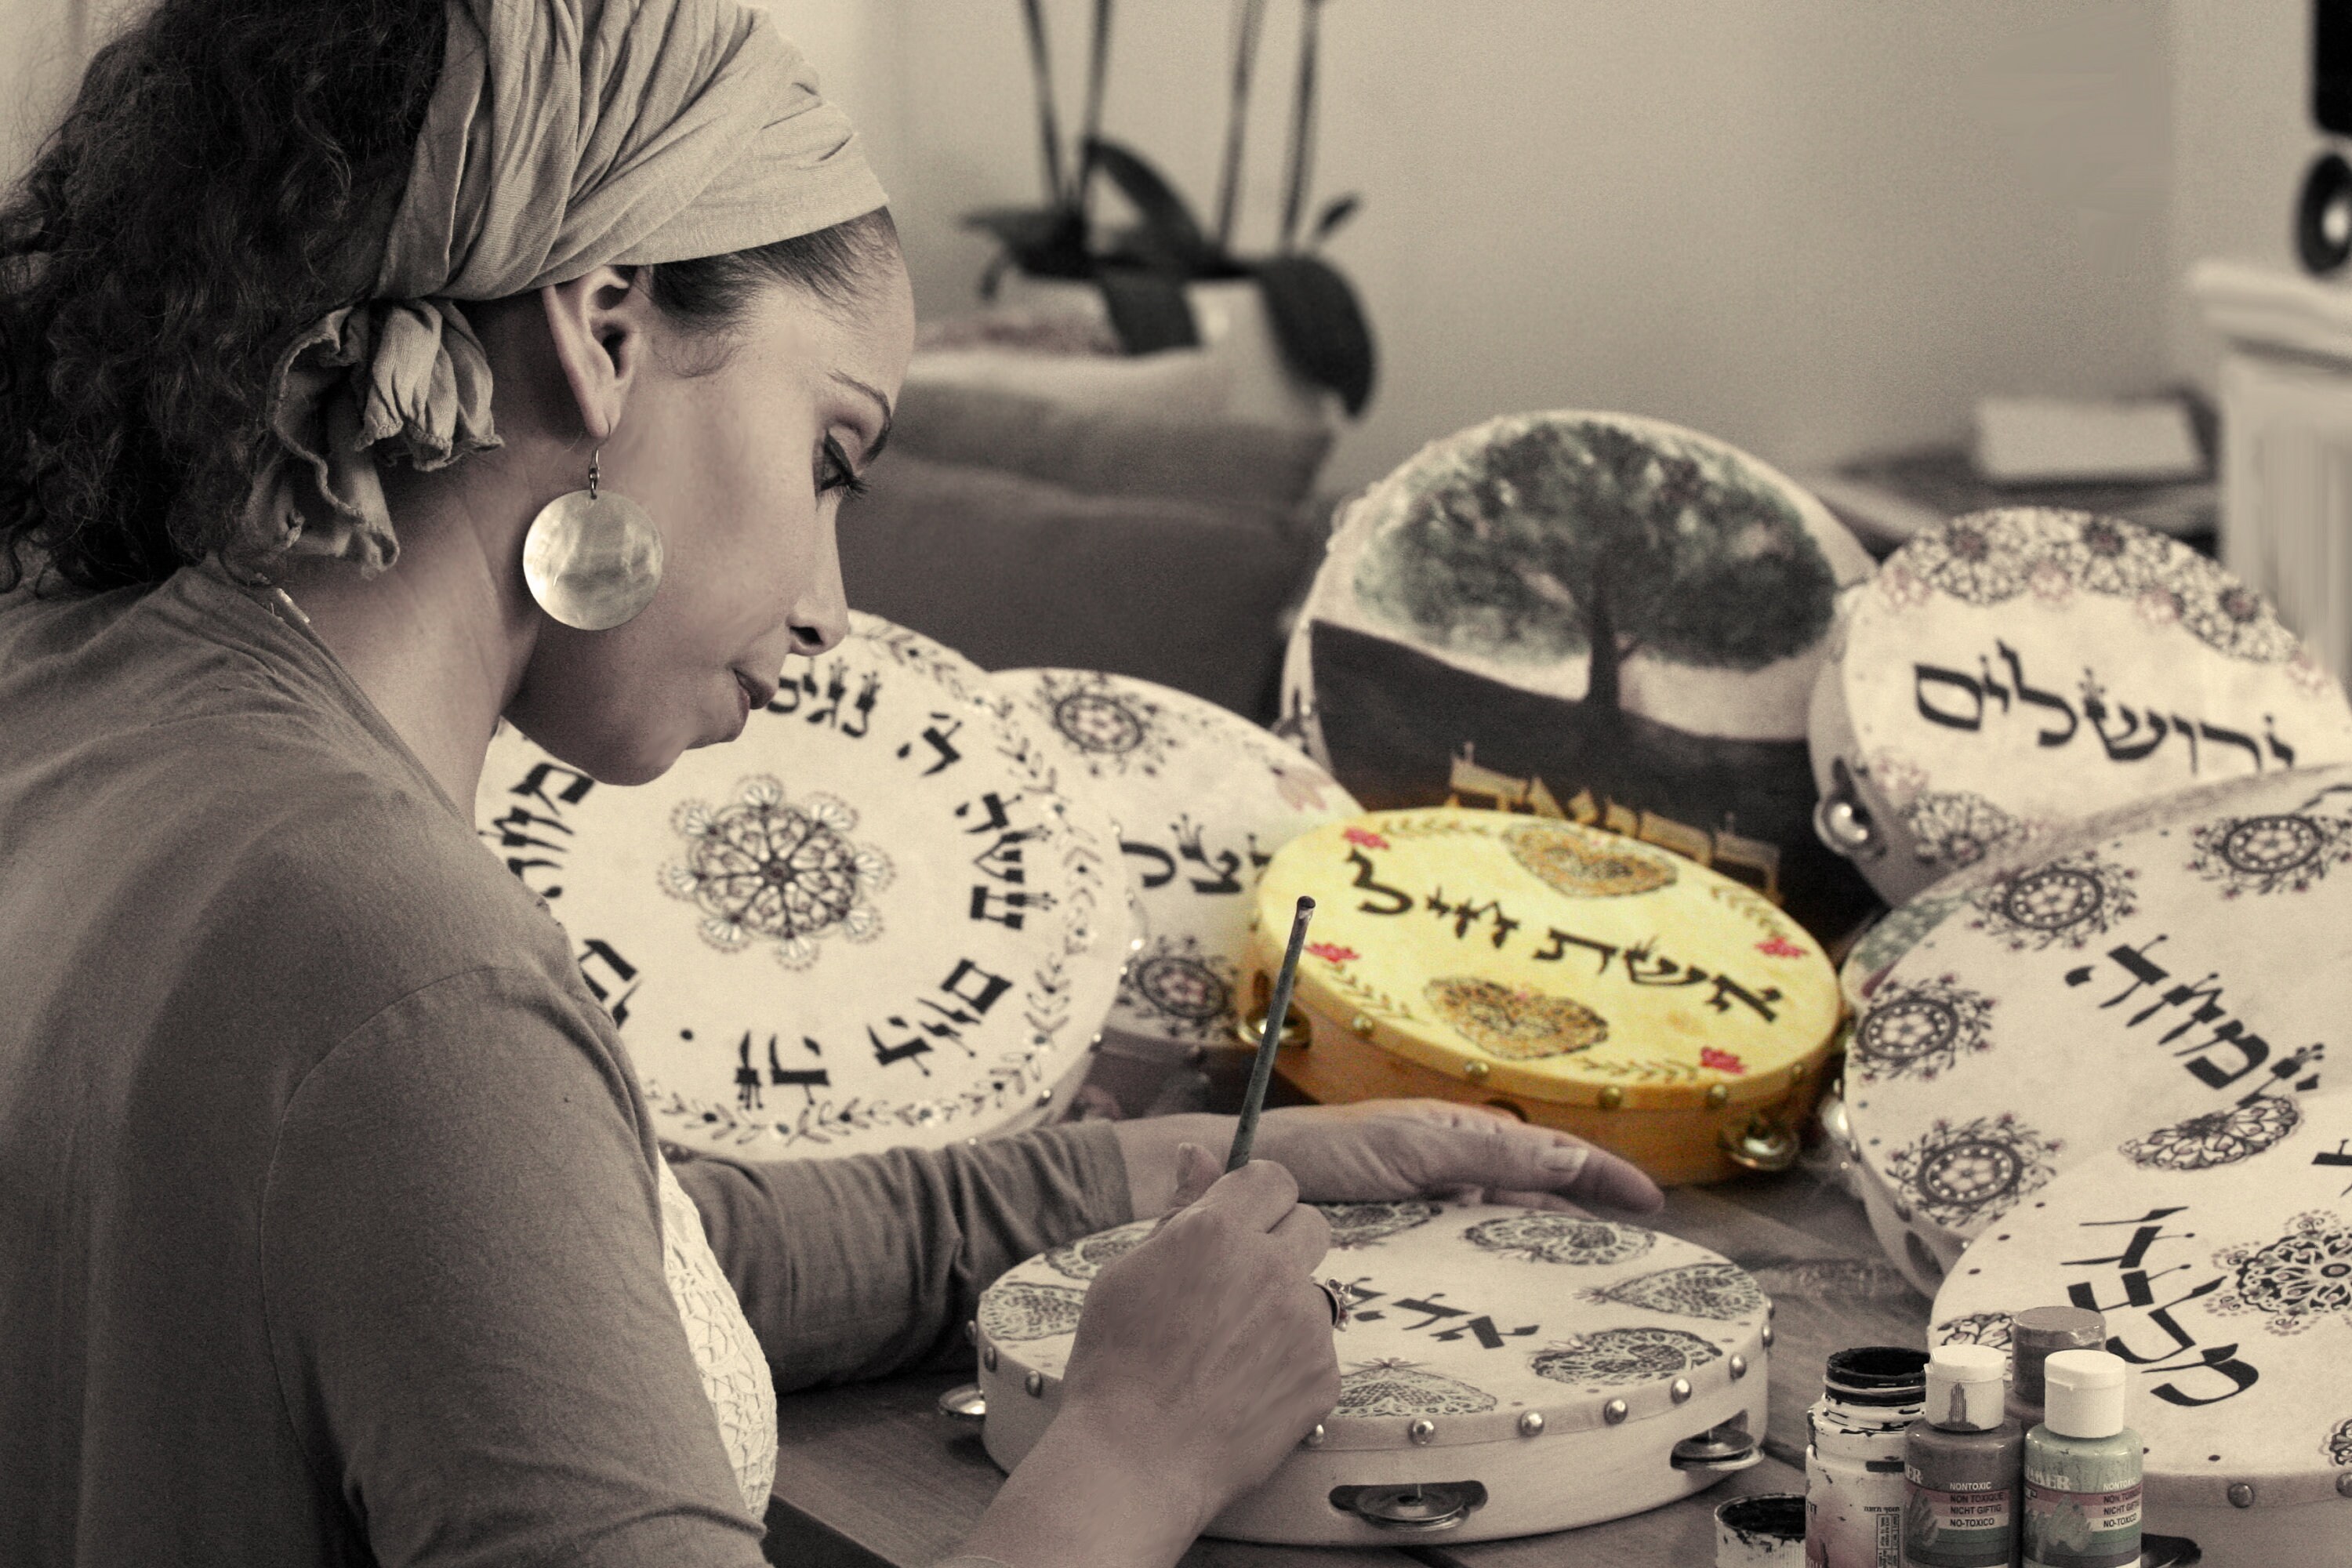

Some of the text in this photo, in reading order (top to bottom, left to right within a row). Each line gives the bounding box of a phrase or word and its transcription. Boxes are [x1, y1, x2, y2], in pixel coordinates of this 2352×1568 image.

[1914, 637, 2296, 775] ירושלים
[1343, 845, 1520, 949] חיל
[734, 1029, 833, 1110] זה
[866, 957, 1014, 1077] היום
[953, 792, 1058, 931] עשה
[1532, 926, 1782, 1022] אשת
[1949, 1481, 1992, 1491] NONTOXIC
[1949, 1491, 2004, 1504] NON TOXIQUE
[1950, 1504, 2002, 1515] NICHT GIFTIG
[2103, 1504, 2125, 1516] NICHT
[1949, 1517, 1995, 1528] NO-TOXICO
